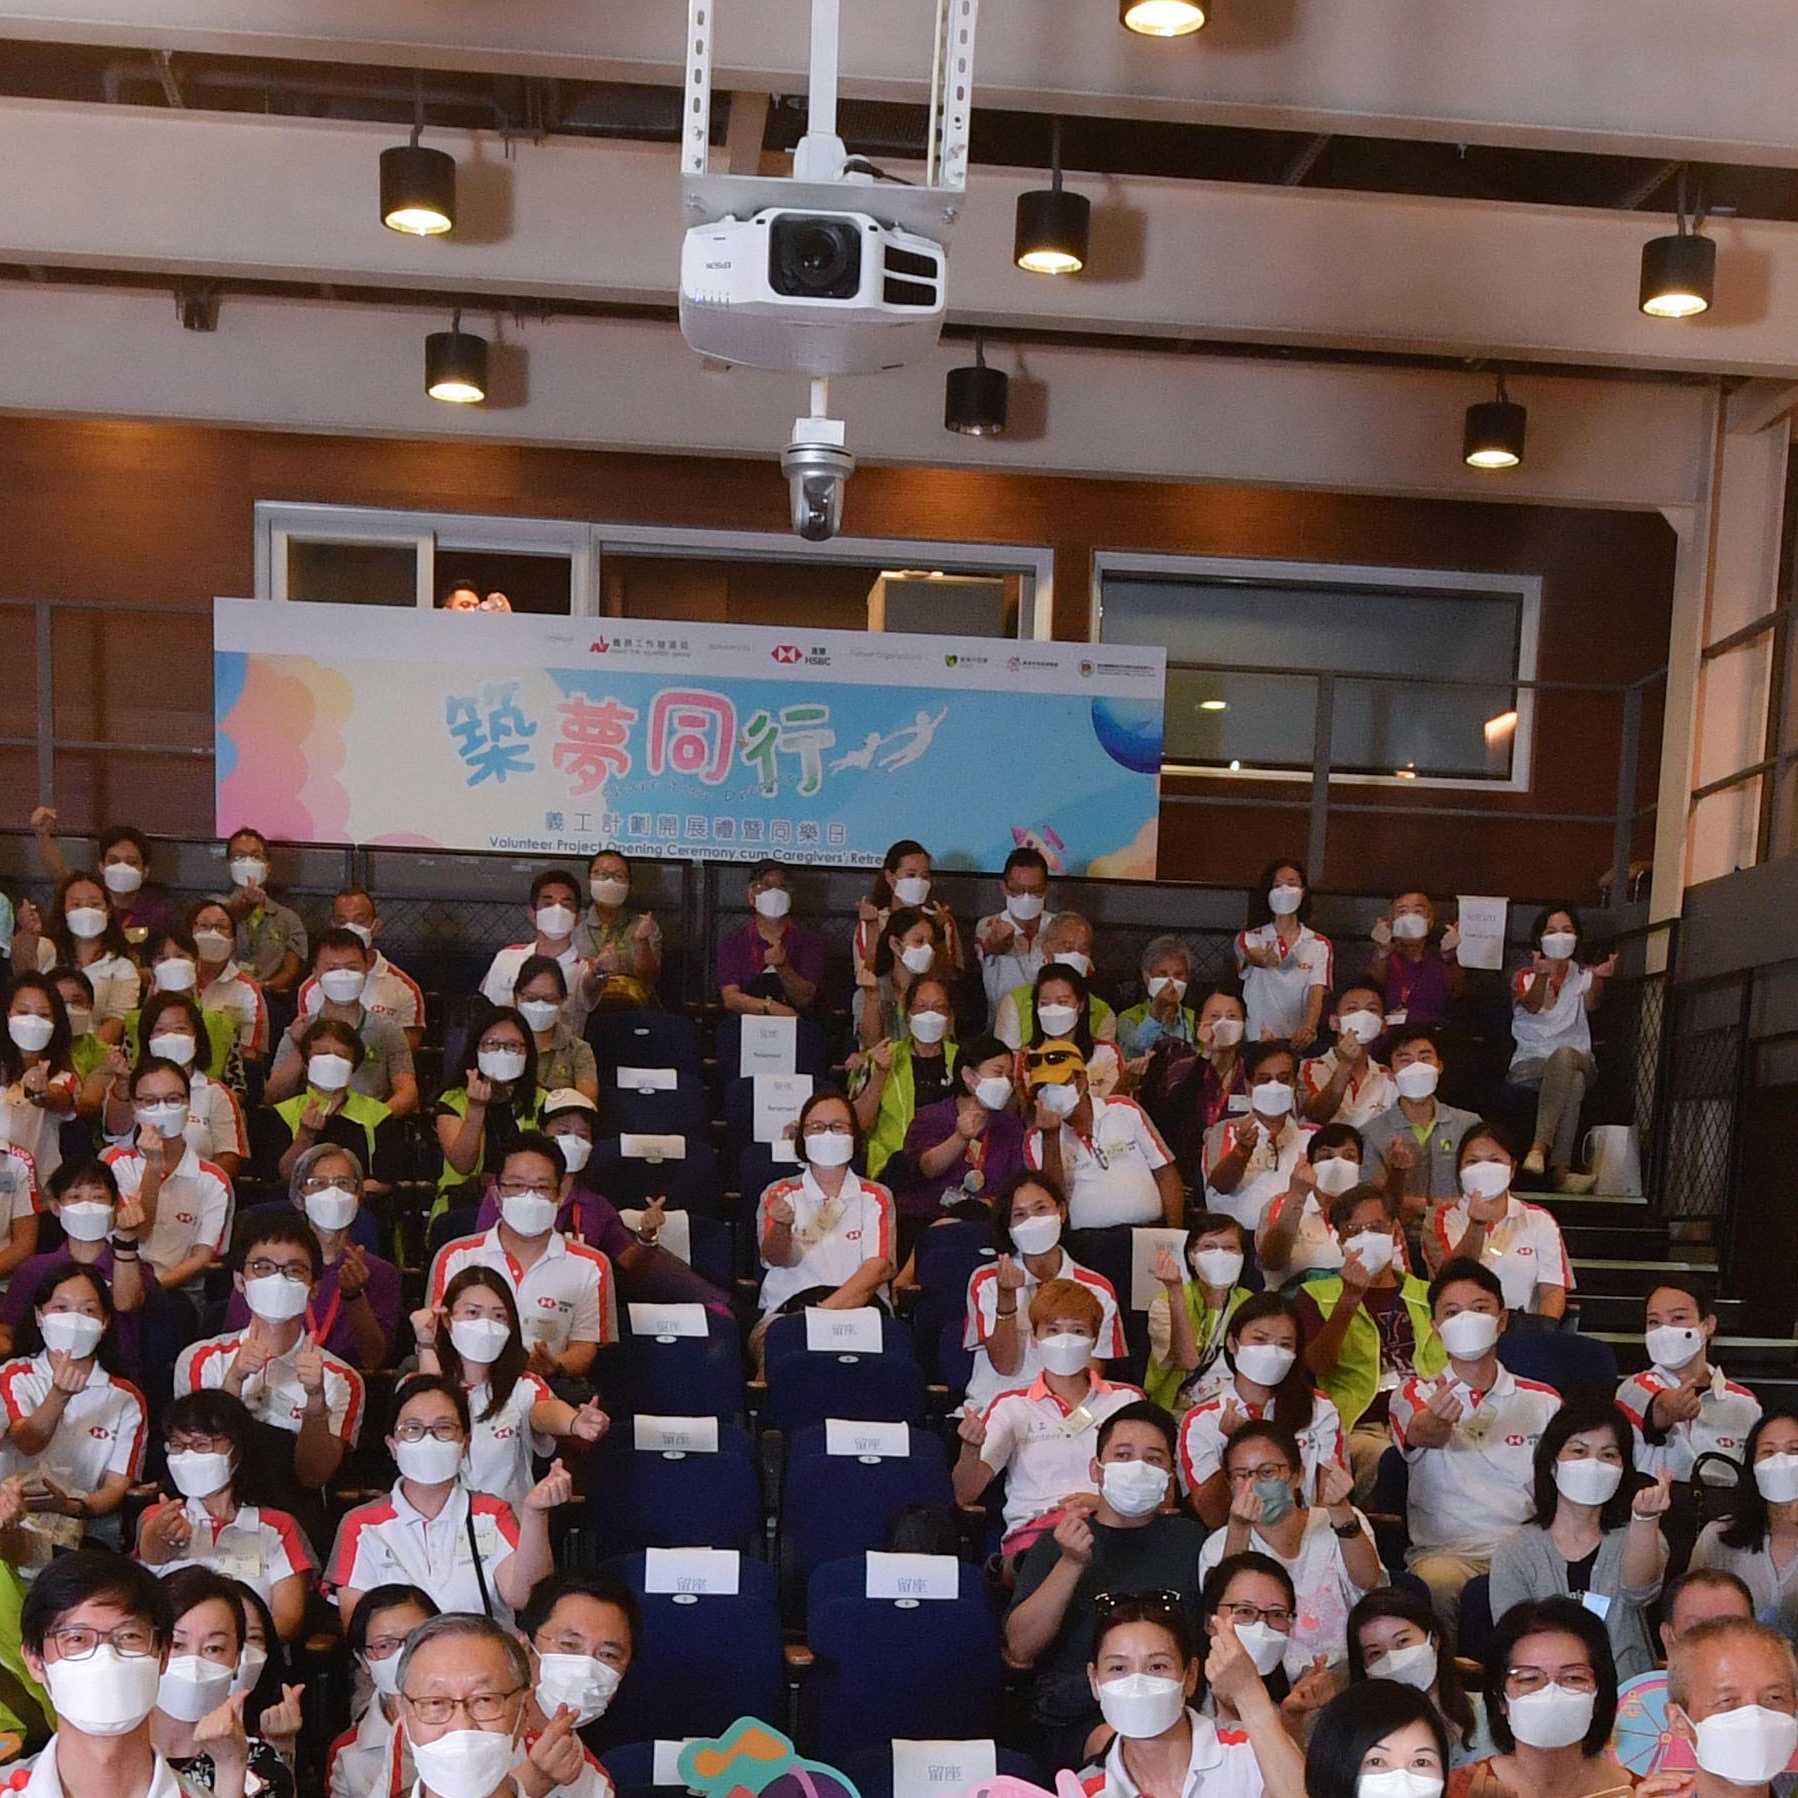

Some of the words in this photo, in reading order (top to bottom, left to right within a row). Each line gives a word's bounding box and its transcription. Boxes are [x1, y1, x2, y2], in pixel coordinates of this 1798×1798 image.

[446, 686, 836, 797] 築夢同行
[545, 811, 847, 845] 義工計劃開展禮暨同樂日
[490, 835, 553, 851] Volunteer
[557, 840, 602, 855] Project
[606, 843, 664, 860] Opening
[666, 845, 735, 862] Ceremony
